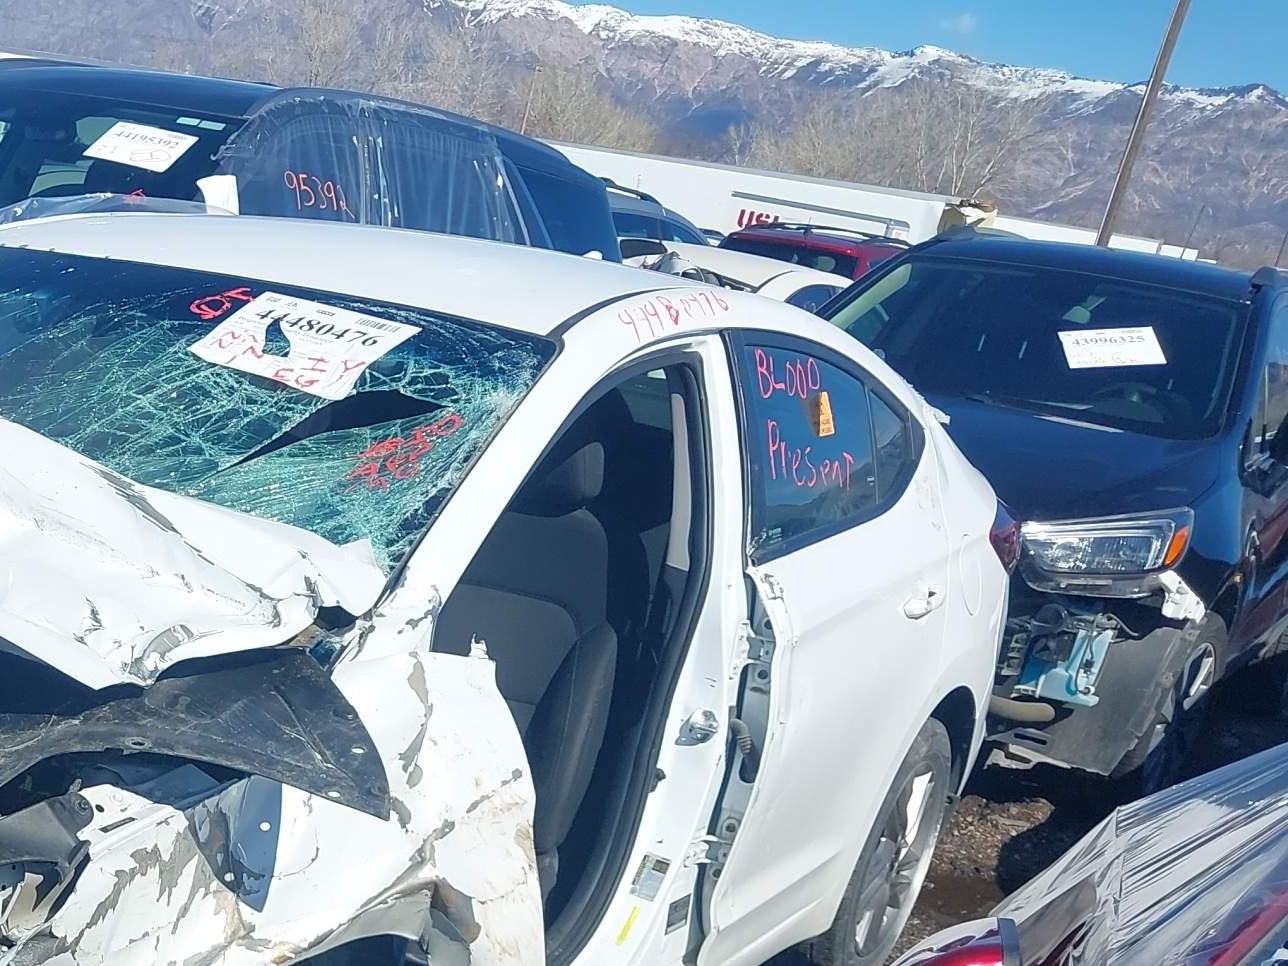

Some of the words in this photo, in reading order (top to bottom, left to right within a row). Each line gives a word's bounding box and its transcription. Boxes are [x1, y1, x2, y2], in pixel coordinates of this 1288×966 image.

[284, 170, 355, 219] 95392
[254, 309, 384, 347] 44480476
[1072, 335, 1145, 346] 43996325
